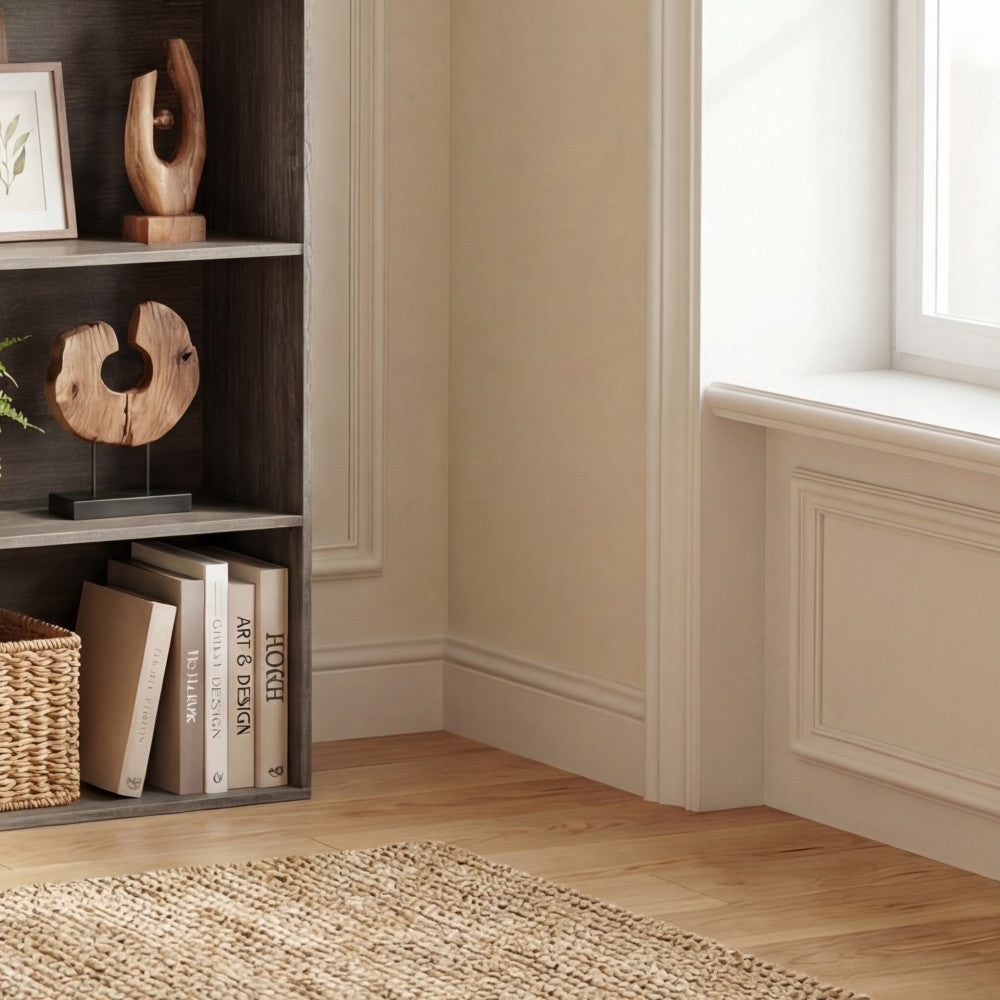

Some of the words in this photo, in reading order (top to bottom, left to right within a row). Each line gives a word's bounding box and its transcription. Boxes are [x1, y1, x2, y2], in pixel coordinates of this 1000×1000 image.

[236, 616, 251, 648] ART
[238, 654, 252, 667] &
[236, 674, 252, 736] DESIGN
